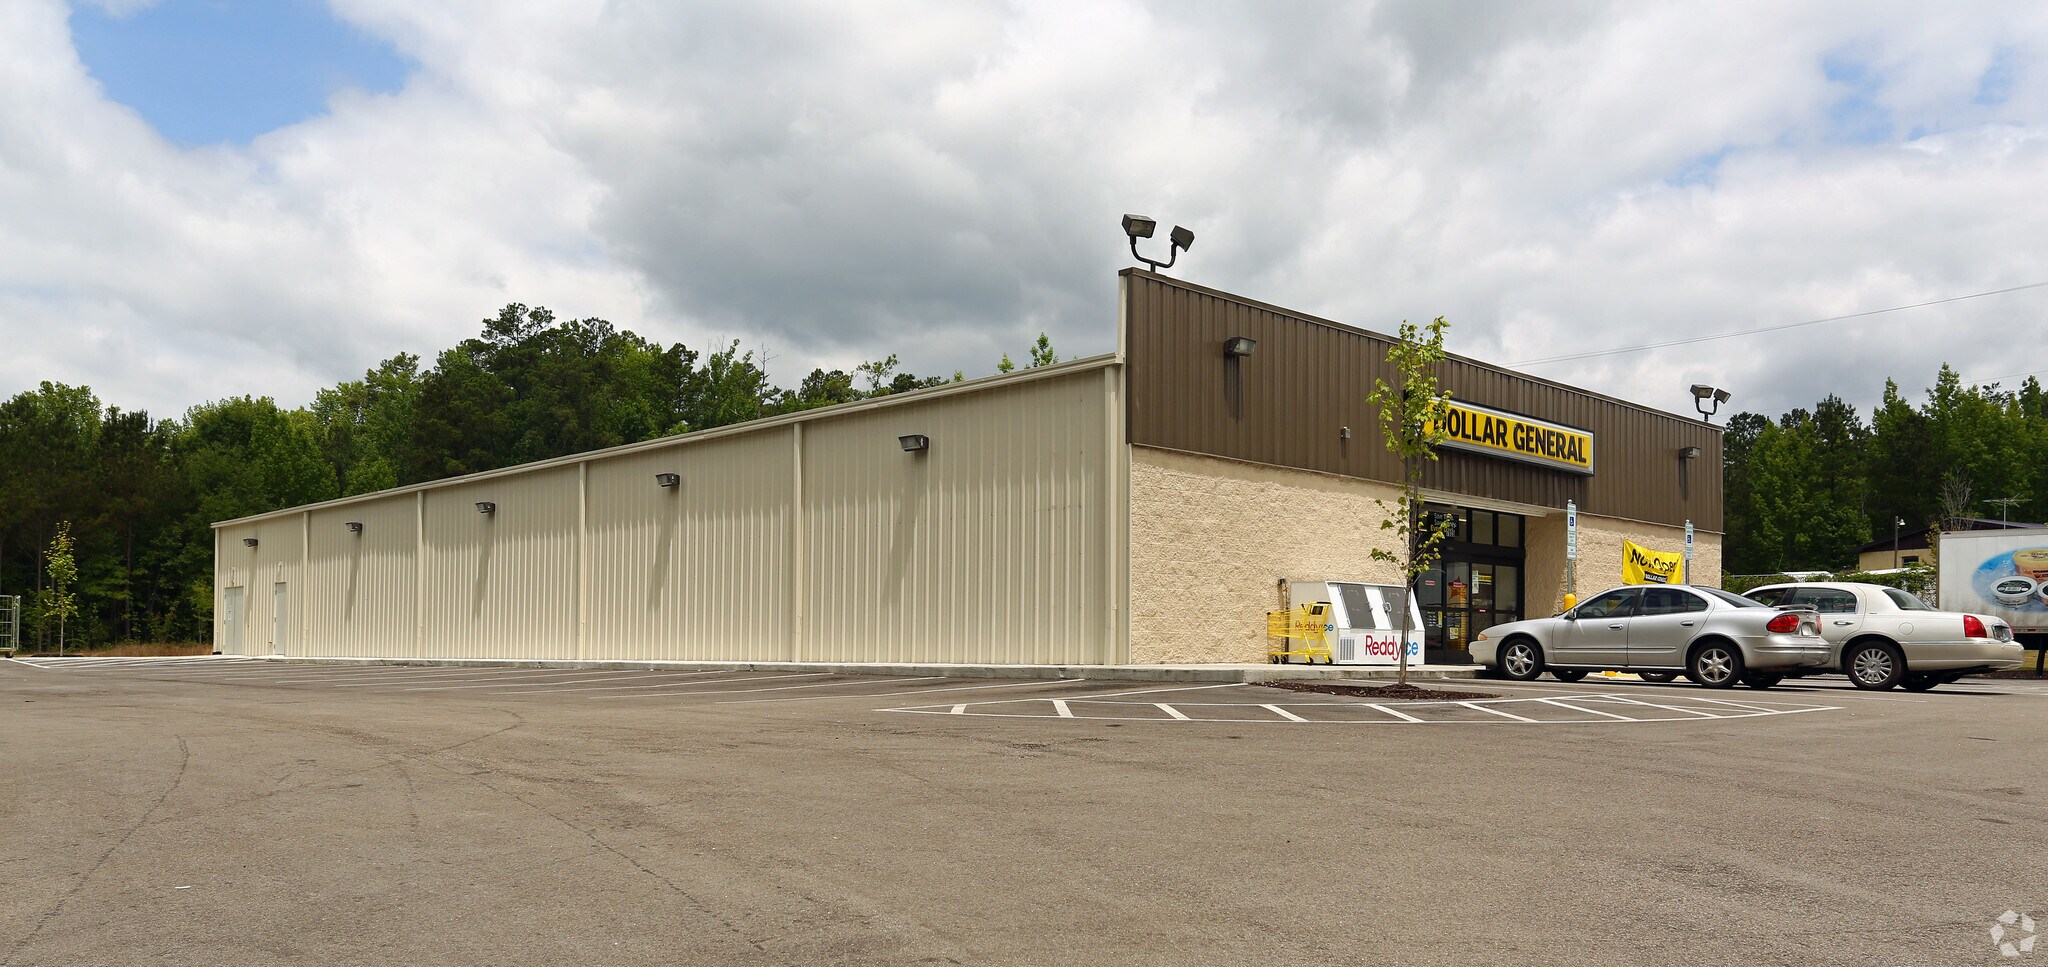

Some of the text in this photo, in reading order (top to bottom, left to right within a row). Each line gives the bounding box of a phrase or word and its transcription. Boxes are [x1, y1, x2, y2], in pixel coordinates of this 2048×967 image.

[1433, 404, 1587, 463] DOLLAR GENERAL
[1365, 634, 1419, 661] Reddy ce
